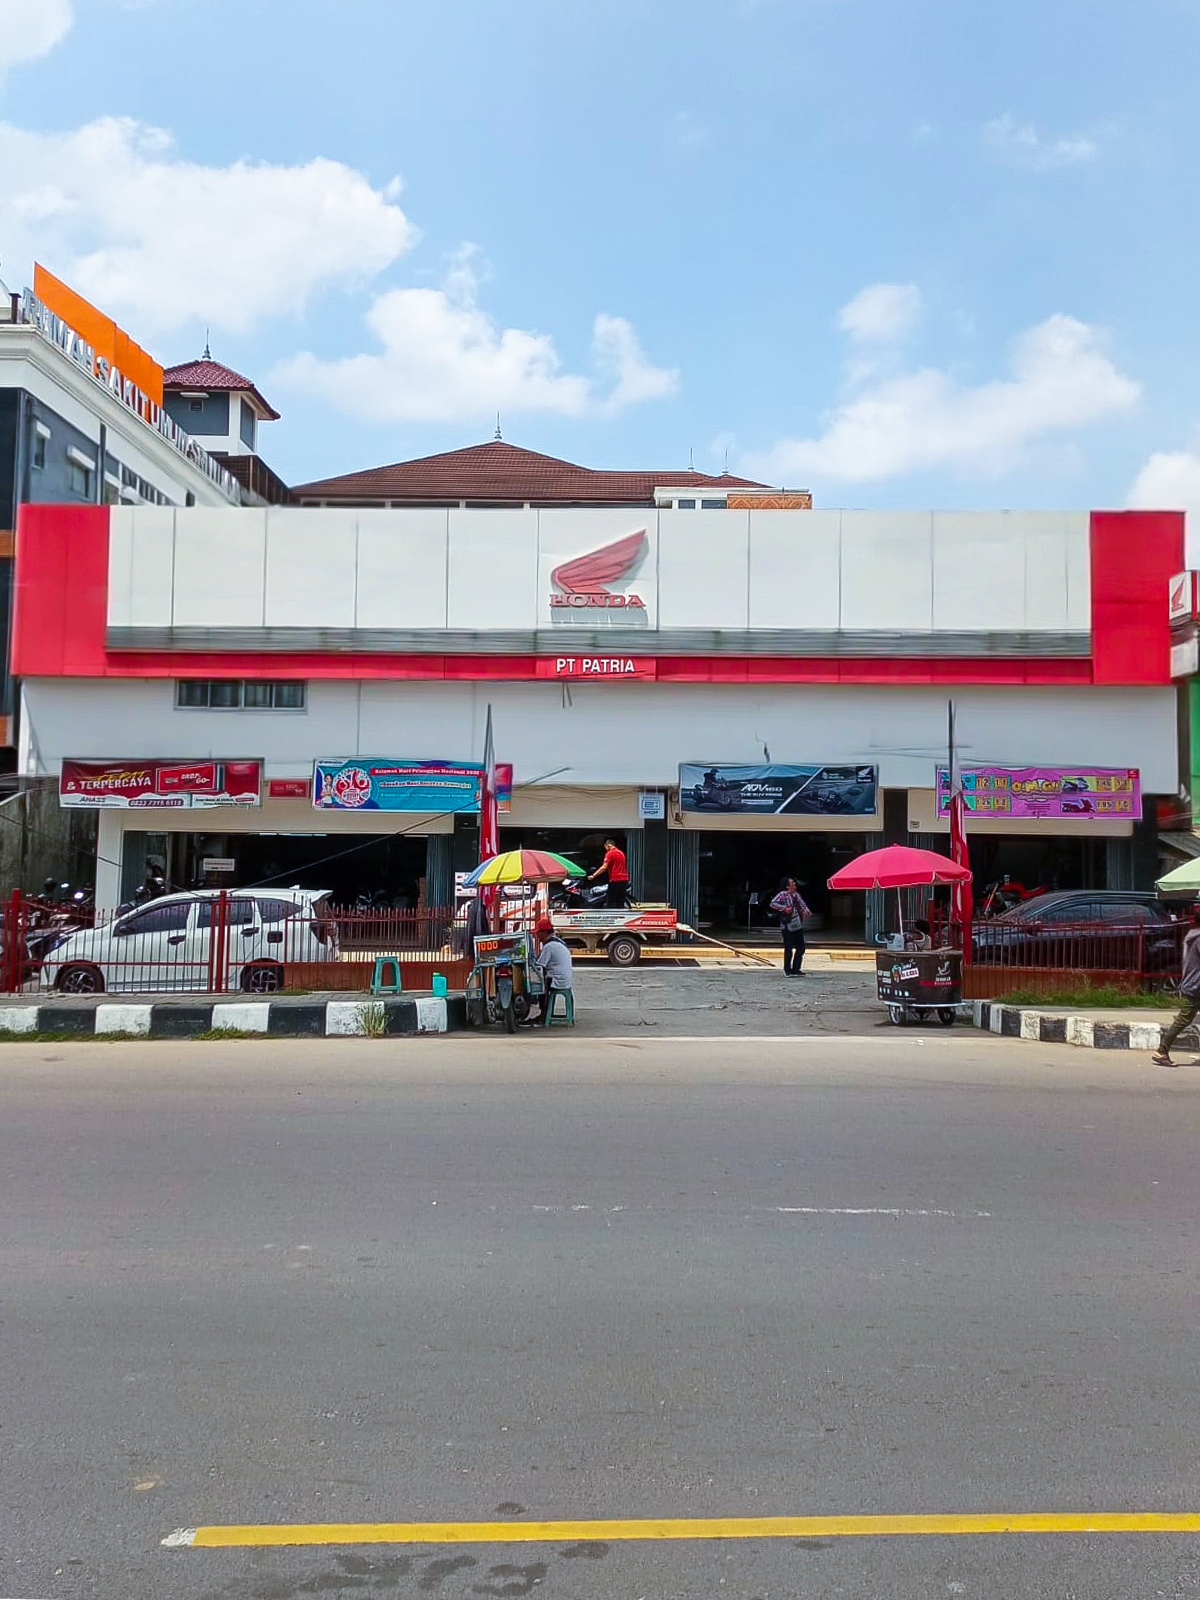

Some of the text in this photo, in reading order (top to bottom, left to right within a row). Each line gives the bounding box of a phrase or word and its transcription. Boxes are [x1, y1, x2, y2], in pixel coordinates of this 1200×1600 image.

[549, 594, 646, 608] HONDA
[556, 658, 636, 673] PT PATRIA
[80, 777, 151, 790] TERPERCAYA
